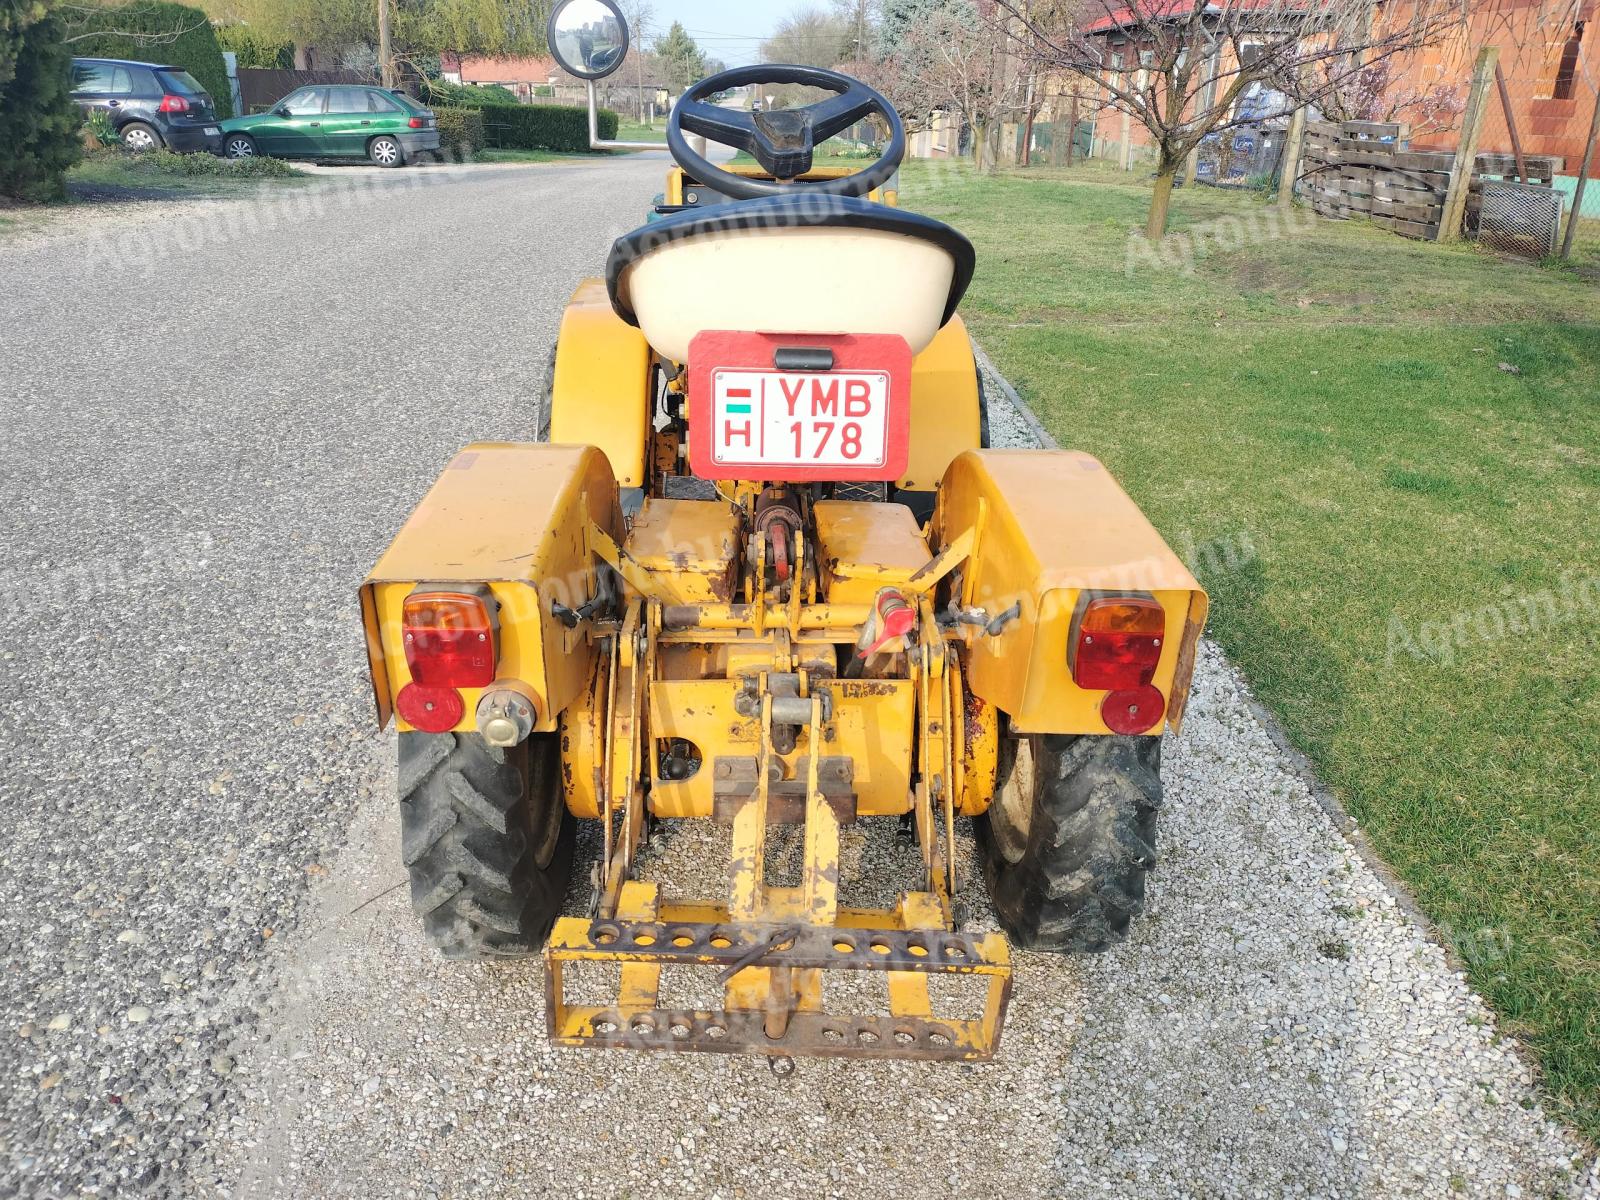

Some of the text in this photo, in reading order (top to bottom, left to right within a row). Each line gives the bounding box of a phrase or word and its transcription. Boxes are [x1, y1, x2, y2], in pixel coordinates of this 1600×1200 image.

[778, 378, 871, 418] YMB
[724, 419, 862, 460] H 178
